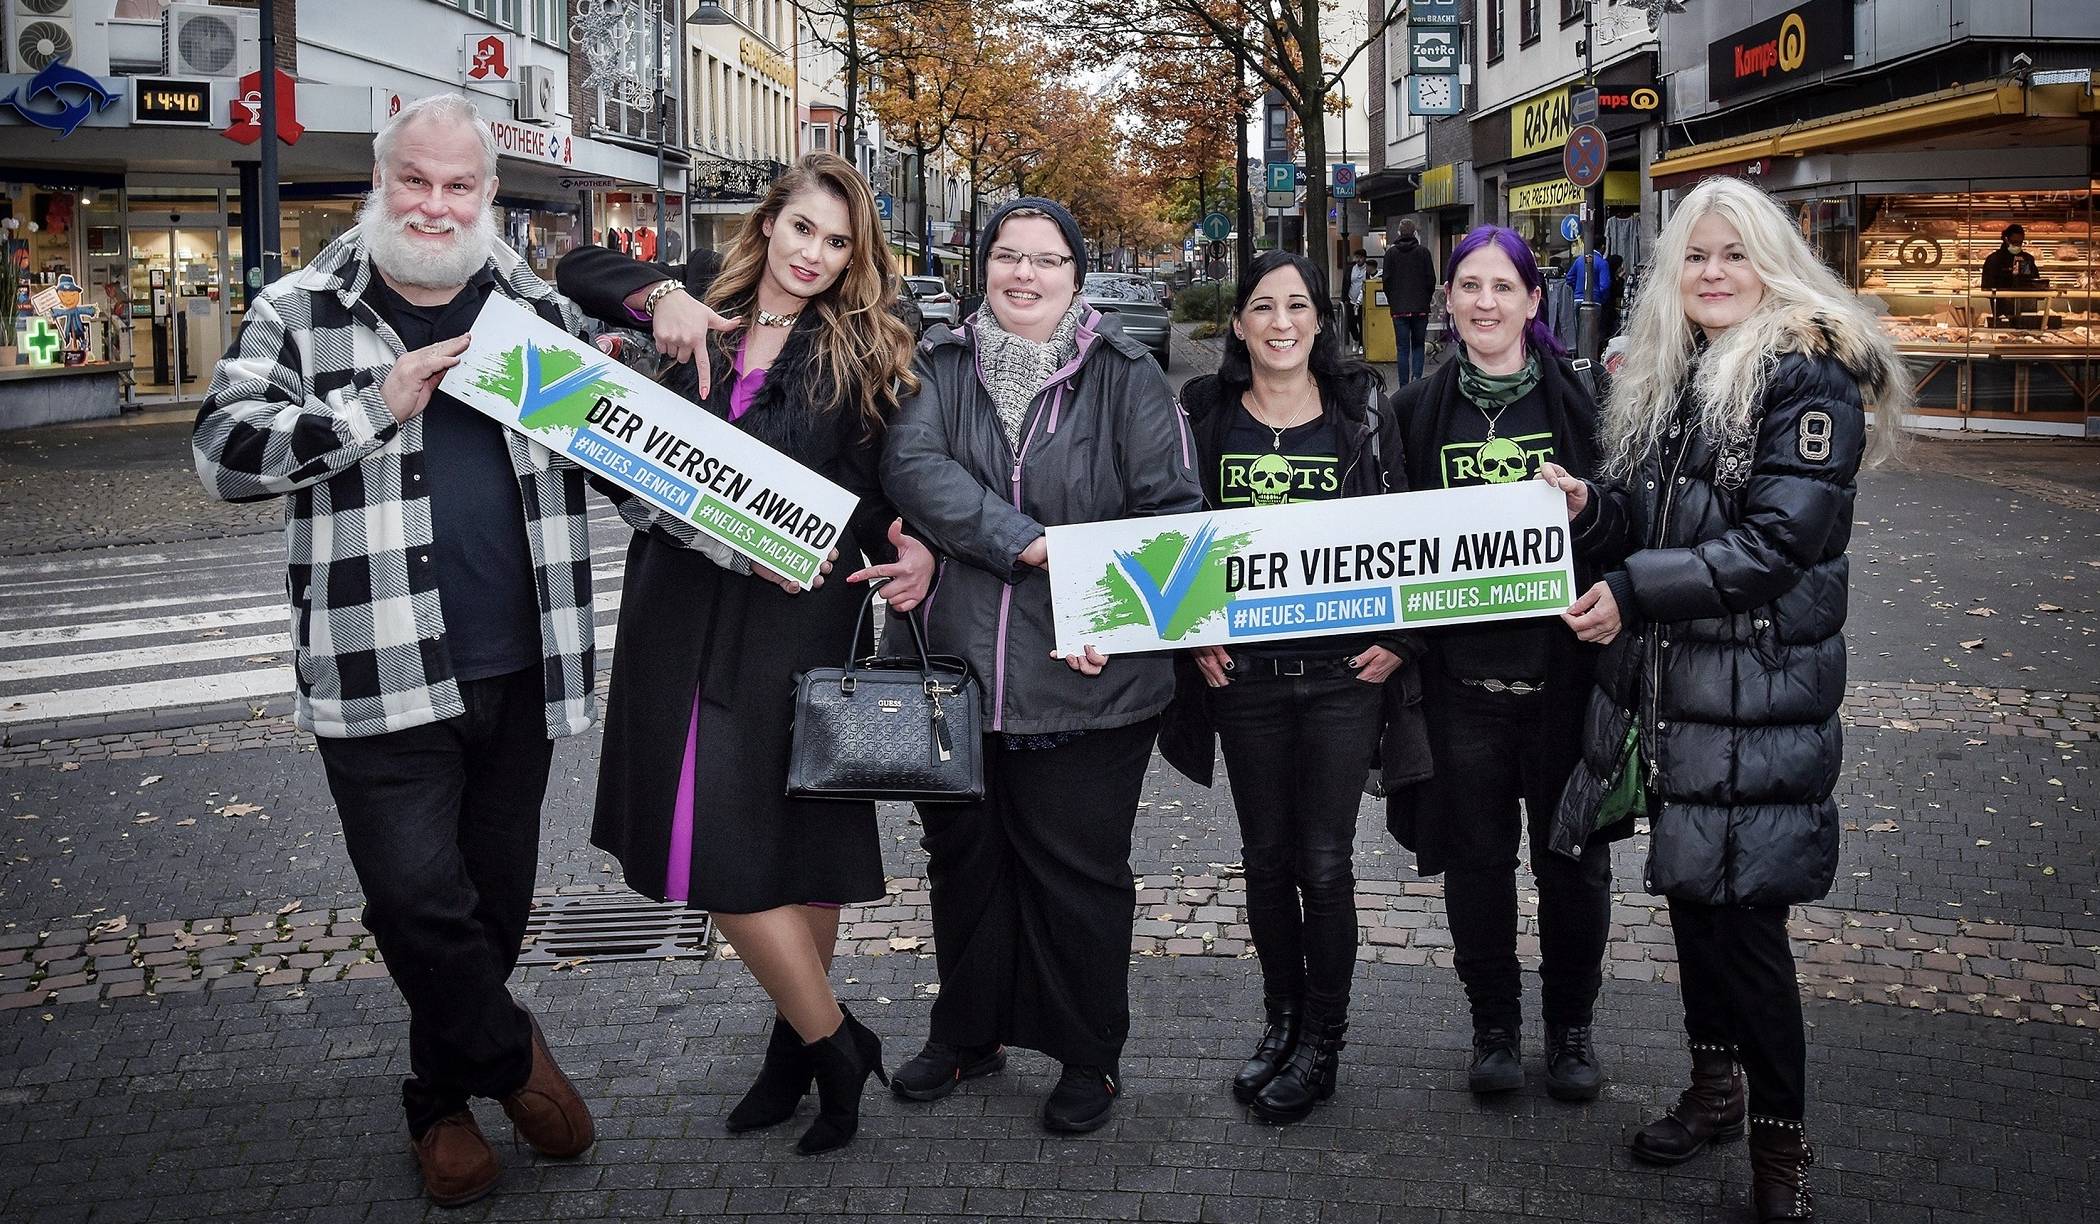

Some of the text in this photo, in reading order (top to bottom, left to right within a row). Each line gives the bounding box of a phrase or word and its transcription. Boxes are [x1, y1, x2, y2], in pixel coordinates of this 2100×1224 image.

[1427, 14, 1456, 23] BRACHT
[1413, 44, 1456, 55] ZentRa
[1734, 39, 1778, 78] Kamps
[143, 92, 200, 112] 14:40
[1598, 92, 1629, 109] mps
[490, 121, 545, 157] APOTHEKE
[1273, 167, 1289, 188] P
[1296, 171, 1307, 181] sky
[1518, 190, 1531, 209] IHR
[1799, 411, 1832, 461] 8
[573, 436, 692, 507] #NEUES_DENKEN
[584, 395, 838, 550] DER VIERSEN AWARD
[698, 503, 814, 576] #NEUES_MACHEN
[1225, 525, 1565, 593] DER VIERSEN AWARD
[1407, 579, 1562, 612] #NEUES_MACHEN
[1233, 597, 1387, 629] #NEUES_DENKEN
[877, 699, 902, 708] GUESS
